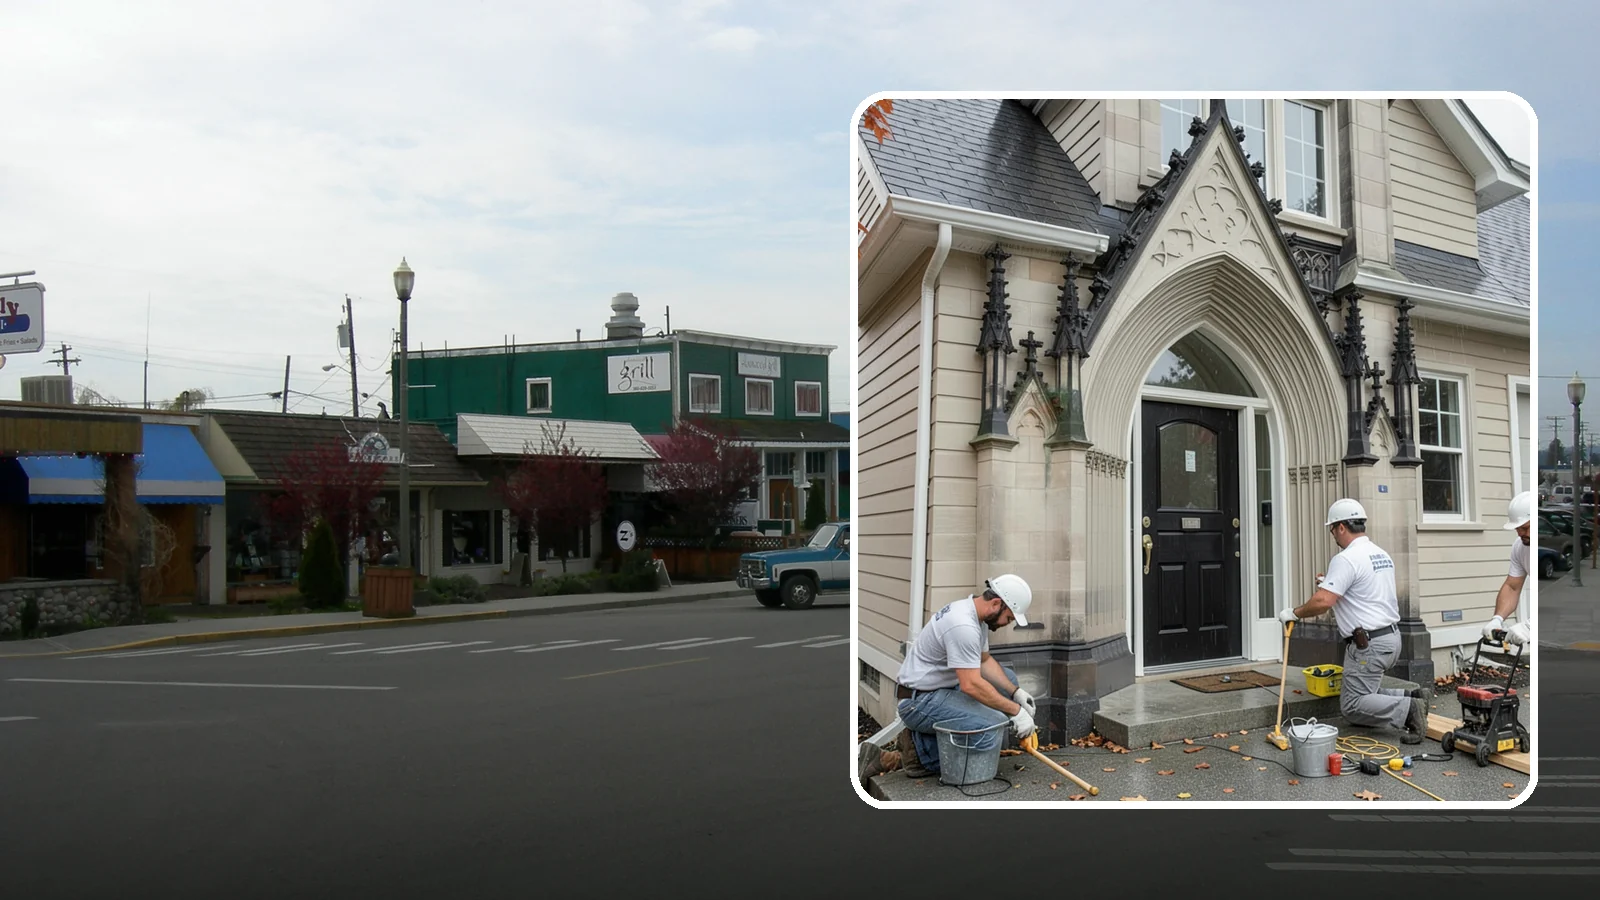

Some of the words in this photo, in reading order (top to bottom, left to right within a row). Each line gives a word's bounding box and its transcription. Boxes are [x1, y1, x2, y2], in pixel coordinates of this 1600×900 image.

[3, 338, 16, 346] Fries
[20, 336, 38, 344] Salads
[618, 355, 655, 391] grill
